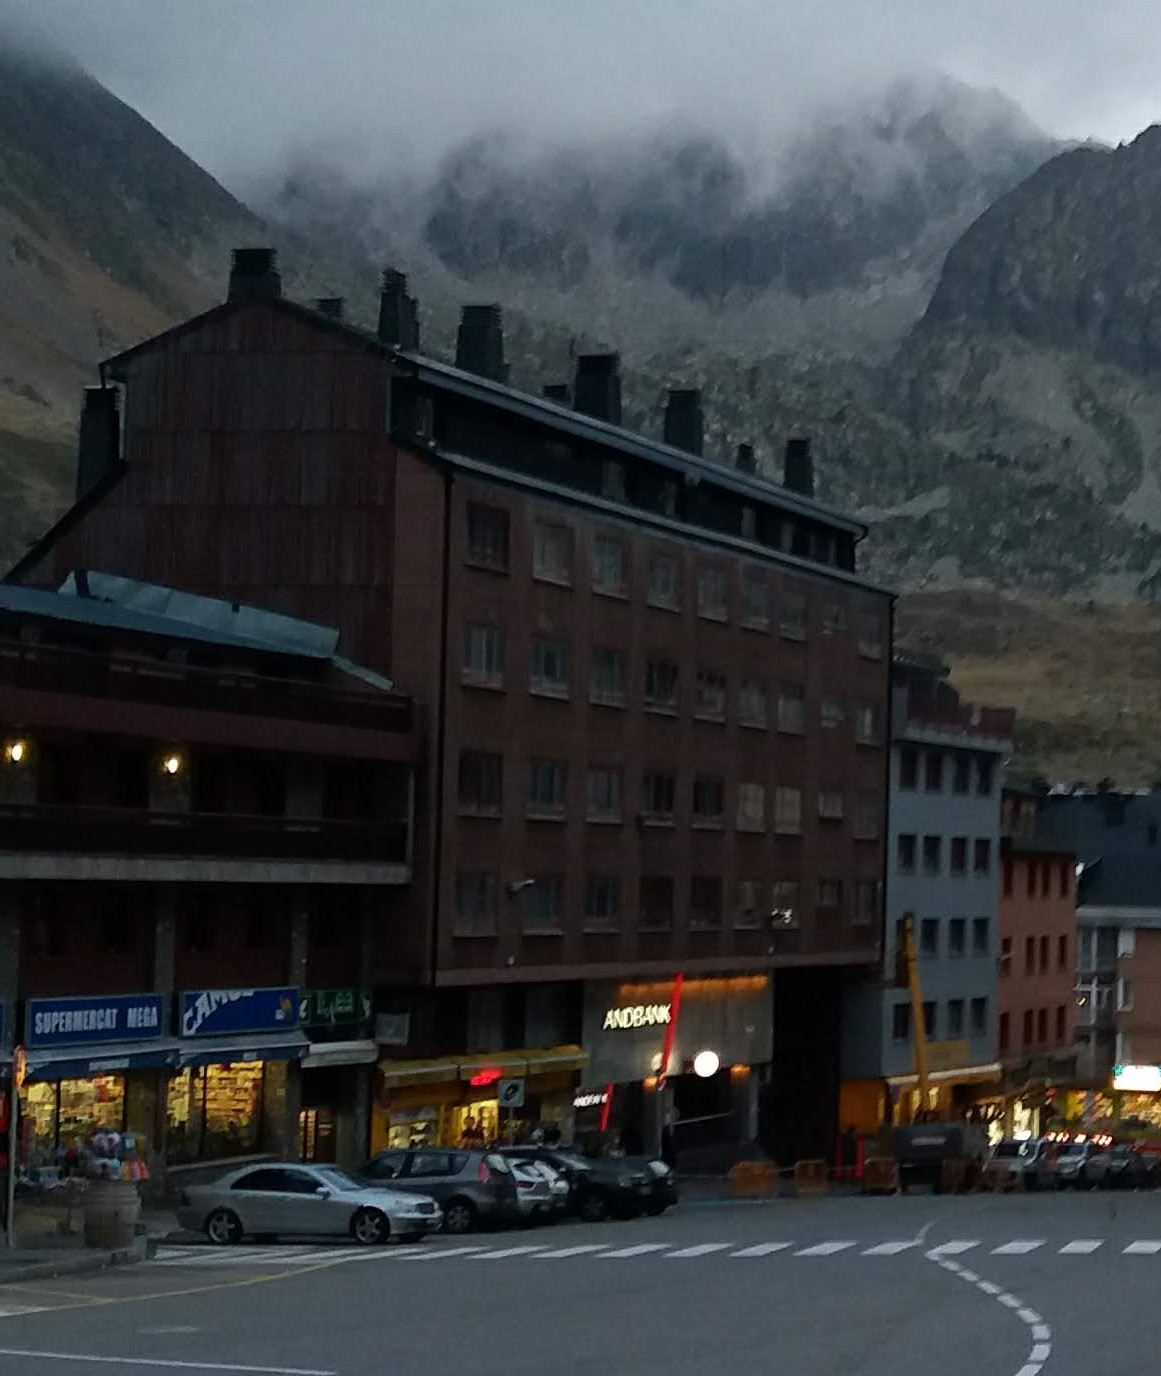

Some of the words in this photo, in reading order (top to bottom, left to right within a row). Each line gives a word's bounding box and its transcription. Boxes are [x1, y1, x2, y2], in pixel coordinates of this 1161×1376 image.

[35, 1008, 118, 1035] SUPERMERCAT
[127, 1005, 158, 1029] MEGA
[602, 1003, 672, 1031] ANDBANK
